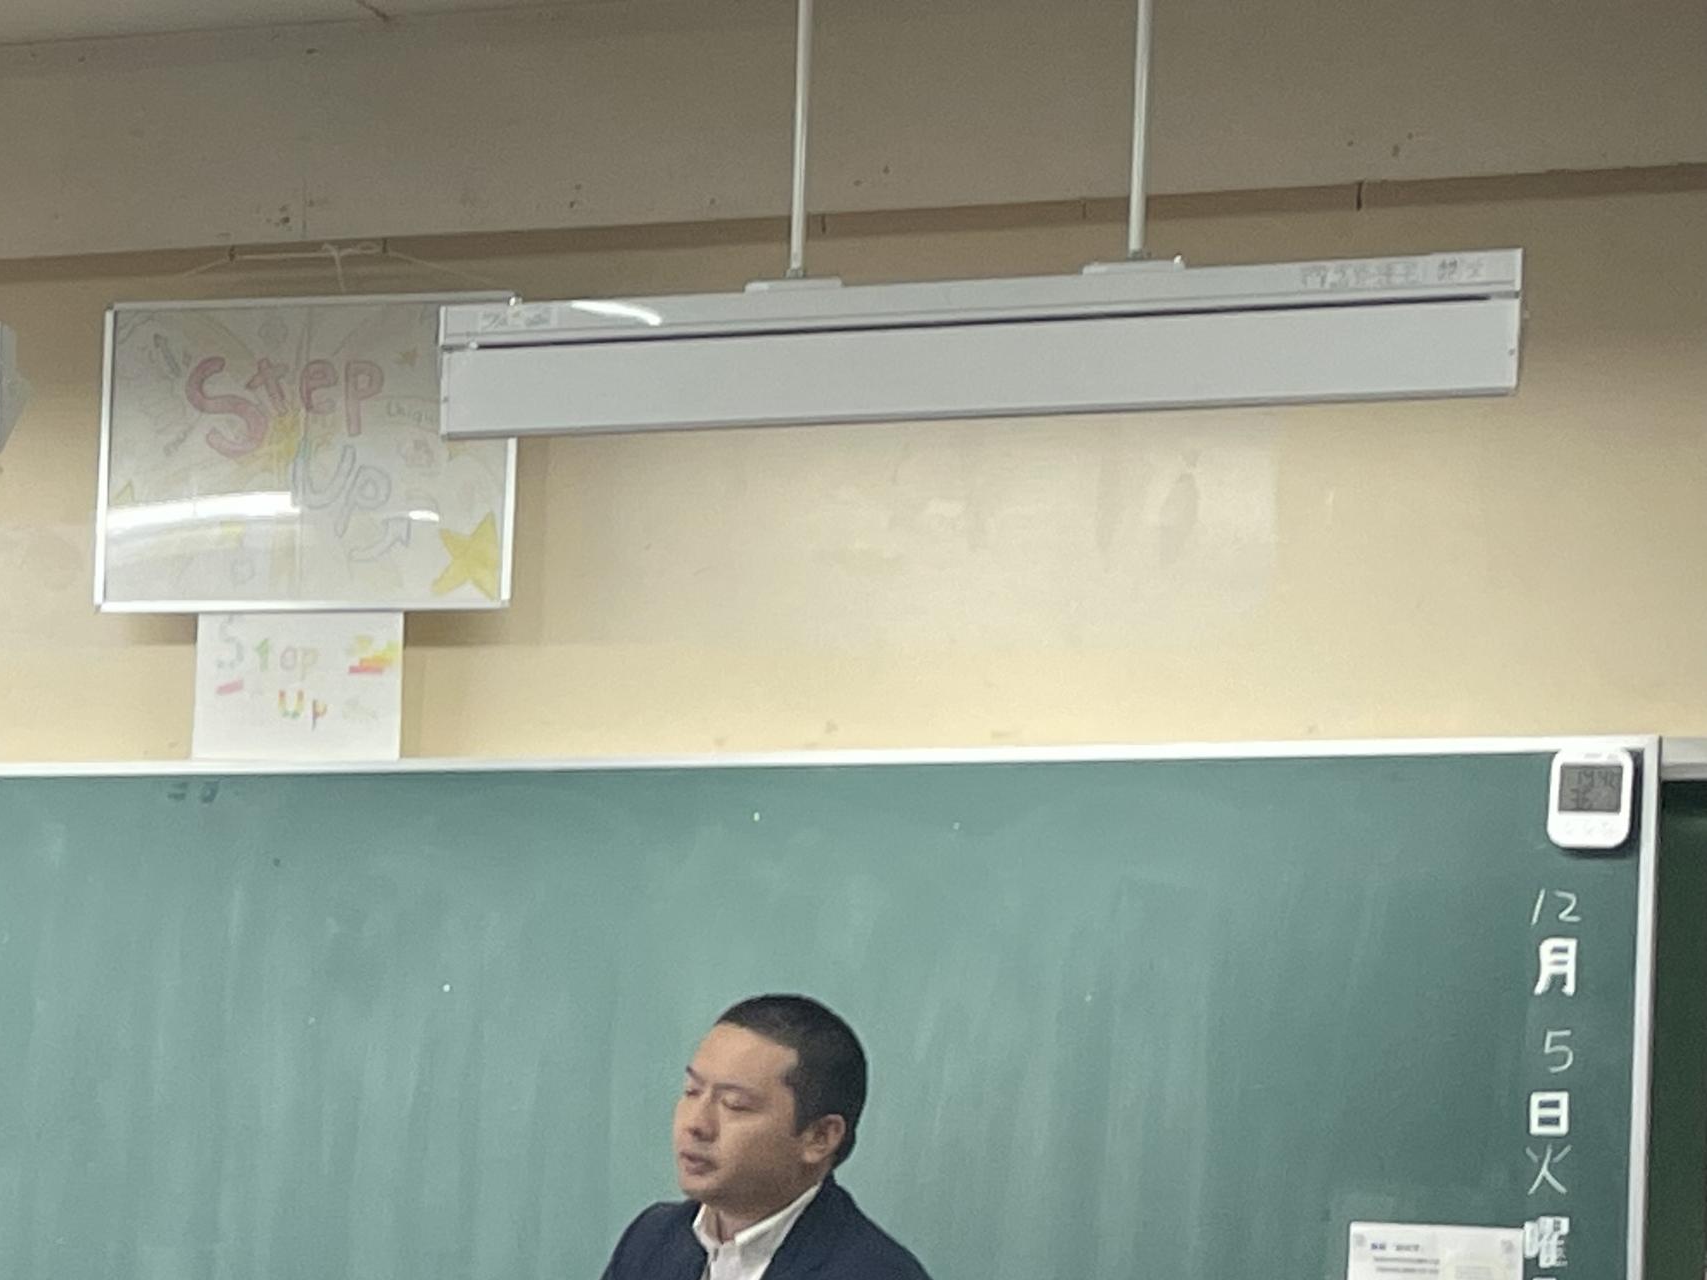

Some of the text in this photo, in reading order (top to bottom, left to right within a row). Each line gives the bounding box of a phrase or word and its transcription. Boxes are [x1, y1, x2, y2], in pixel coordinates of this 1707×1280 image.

[186, 356, 384, 458] Step
[292, 442, 392, 539] Up
[278, 689, 329, 731] Up
